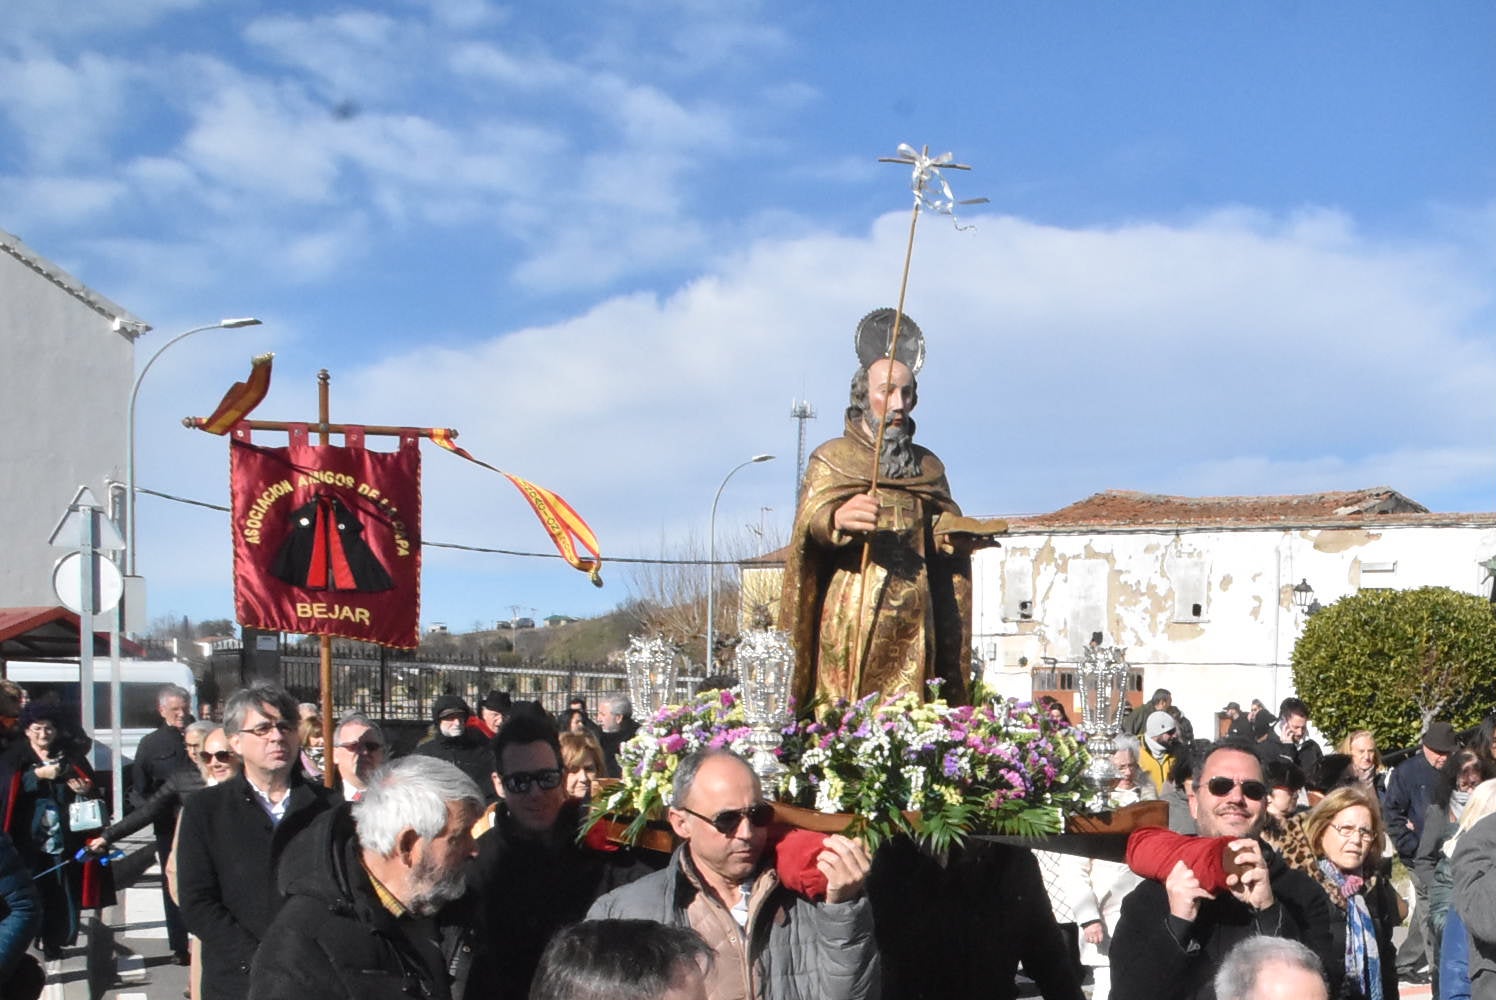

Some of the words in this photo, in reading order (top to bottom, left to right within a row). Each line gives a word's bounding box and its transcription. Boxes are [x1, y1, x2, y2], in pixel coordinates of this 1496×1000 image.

[244, 480, 294, 545] ASOCIACION
[297, 470, 355, 488] AMIGOS
[357, 483, 380, 499] DE
[296, 602, 371, 626] BEJAR
